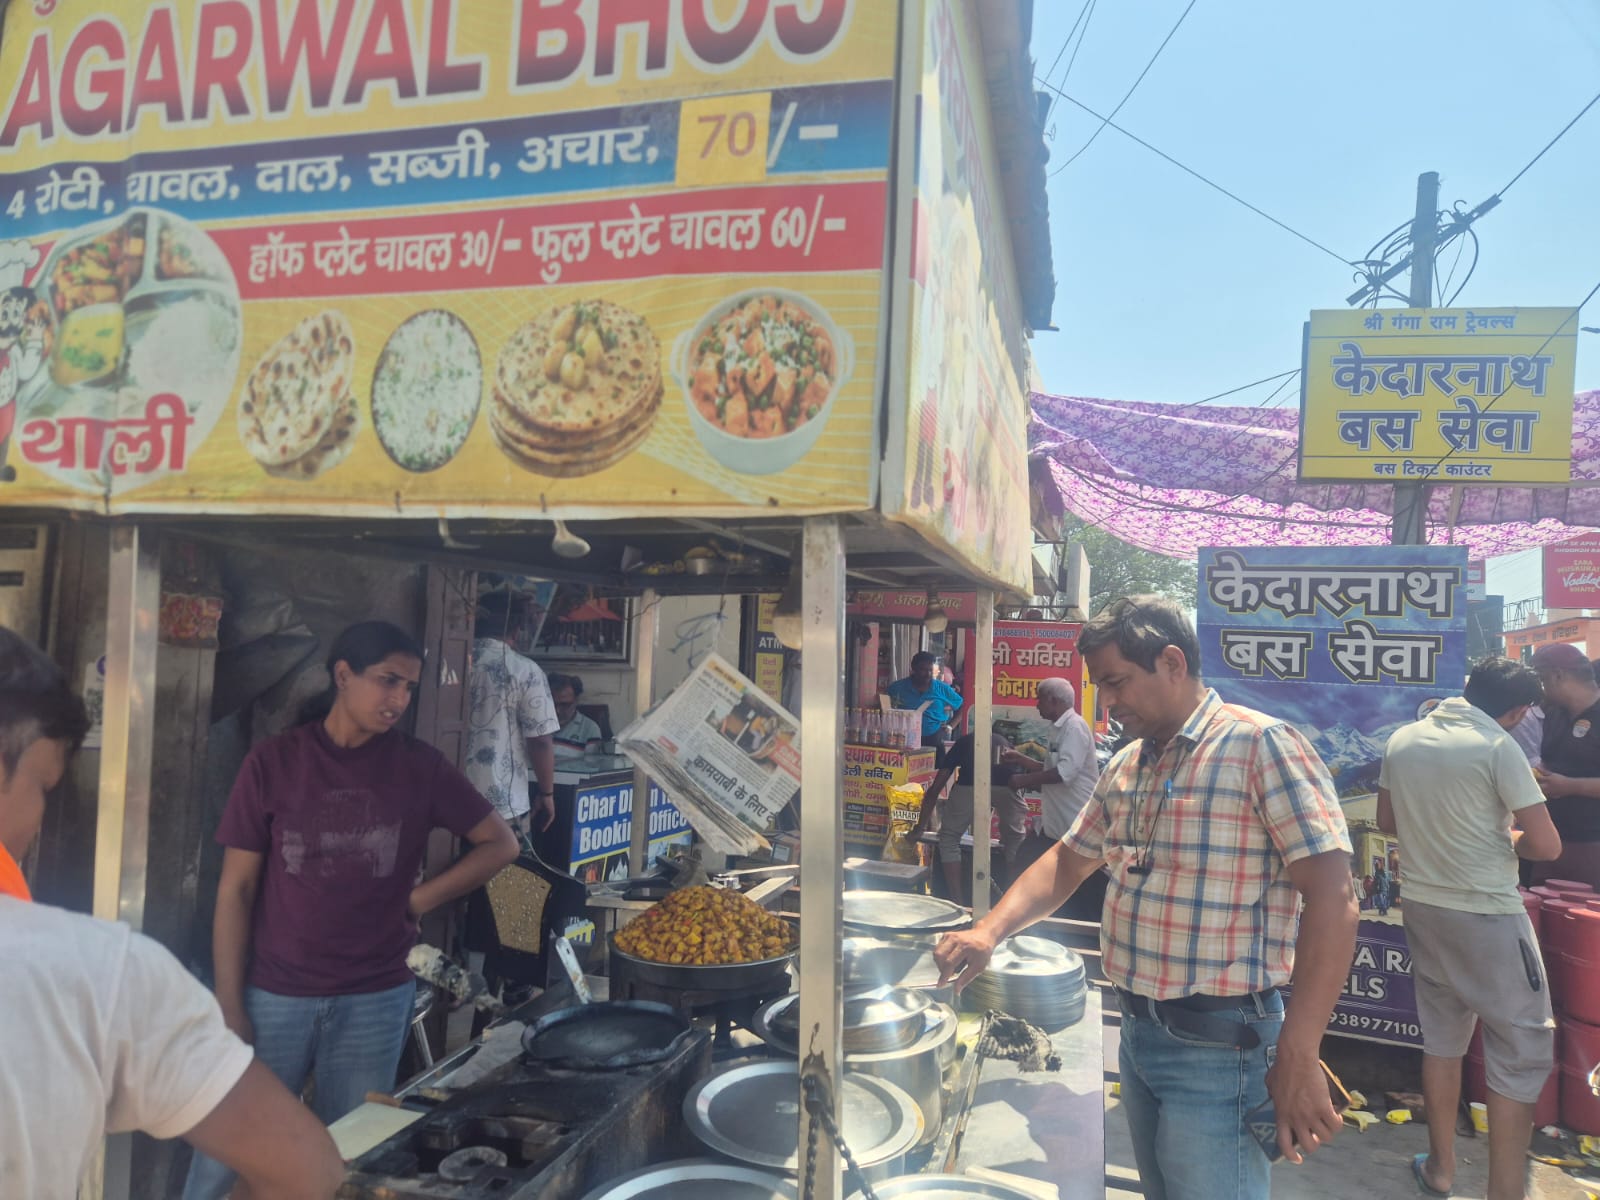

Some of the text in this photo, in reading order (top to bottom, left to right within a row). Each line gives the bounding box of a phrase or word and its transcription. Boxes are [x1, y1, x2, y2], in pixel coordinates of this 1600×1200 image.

[0, 0, 486, 149] AGARWAL
[6, 189, 26, 219] 4
[35, 166, 115, 215] रोटी,
[126, 165, 240, 203] चावल,
[256, 154, 351, 192] दाल,
[368, 129, 502, 187] सब्जी,
[517, 124, 659, 174] अचार,
[248, 195, 846, 283] हॉफ प्लेट चावल 30/- फुल प्लेट चावल 60/-
[1363, 311, 1517, 333] श्री गंगा राम ट्रेवल्स
[1331, 341, 1554, 399] केदारनाथ
[21, 393, 195, 476] थाली
[1336, 396, 1540, 454] बस सेवा
[1374, 460, 1493, 477] बस टिकट काउंटर
[1209, 552, 1458, 616] केदारनाथ
[1562, 572, 1600, 589] Vadila
[759, 636, 783, 649] ATM
[1016, 643, 1072, 667] सर्विस
[1223, 621, 1439, 682] बस सेवा
[997, 671, 1041, 698] केदार
[577, 794, 616, 823] Char
[579, 818, 632, 854] Booki
[1329, 1011, 1423, 1037] 938977110
